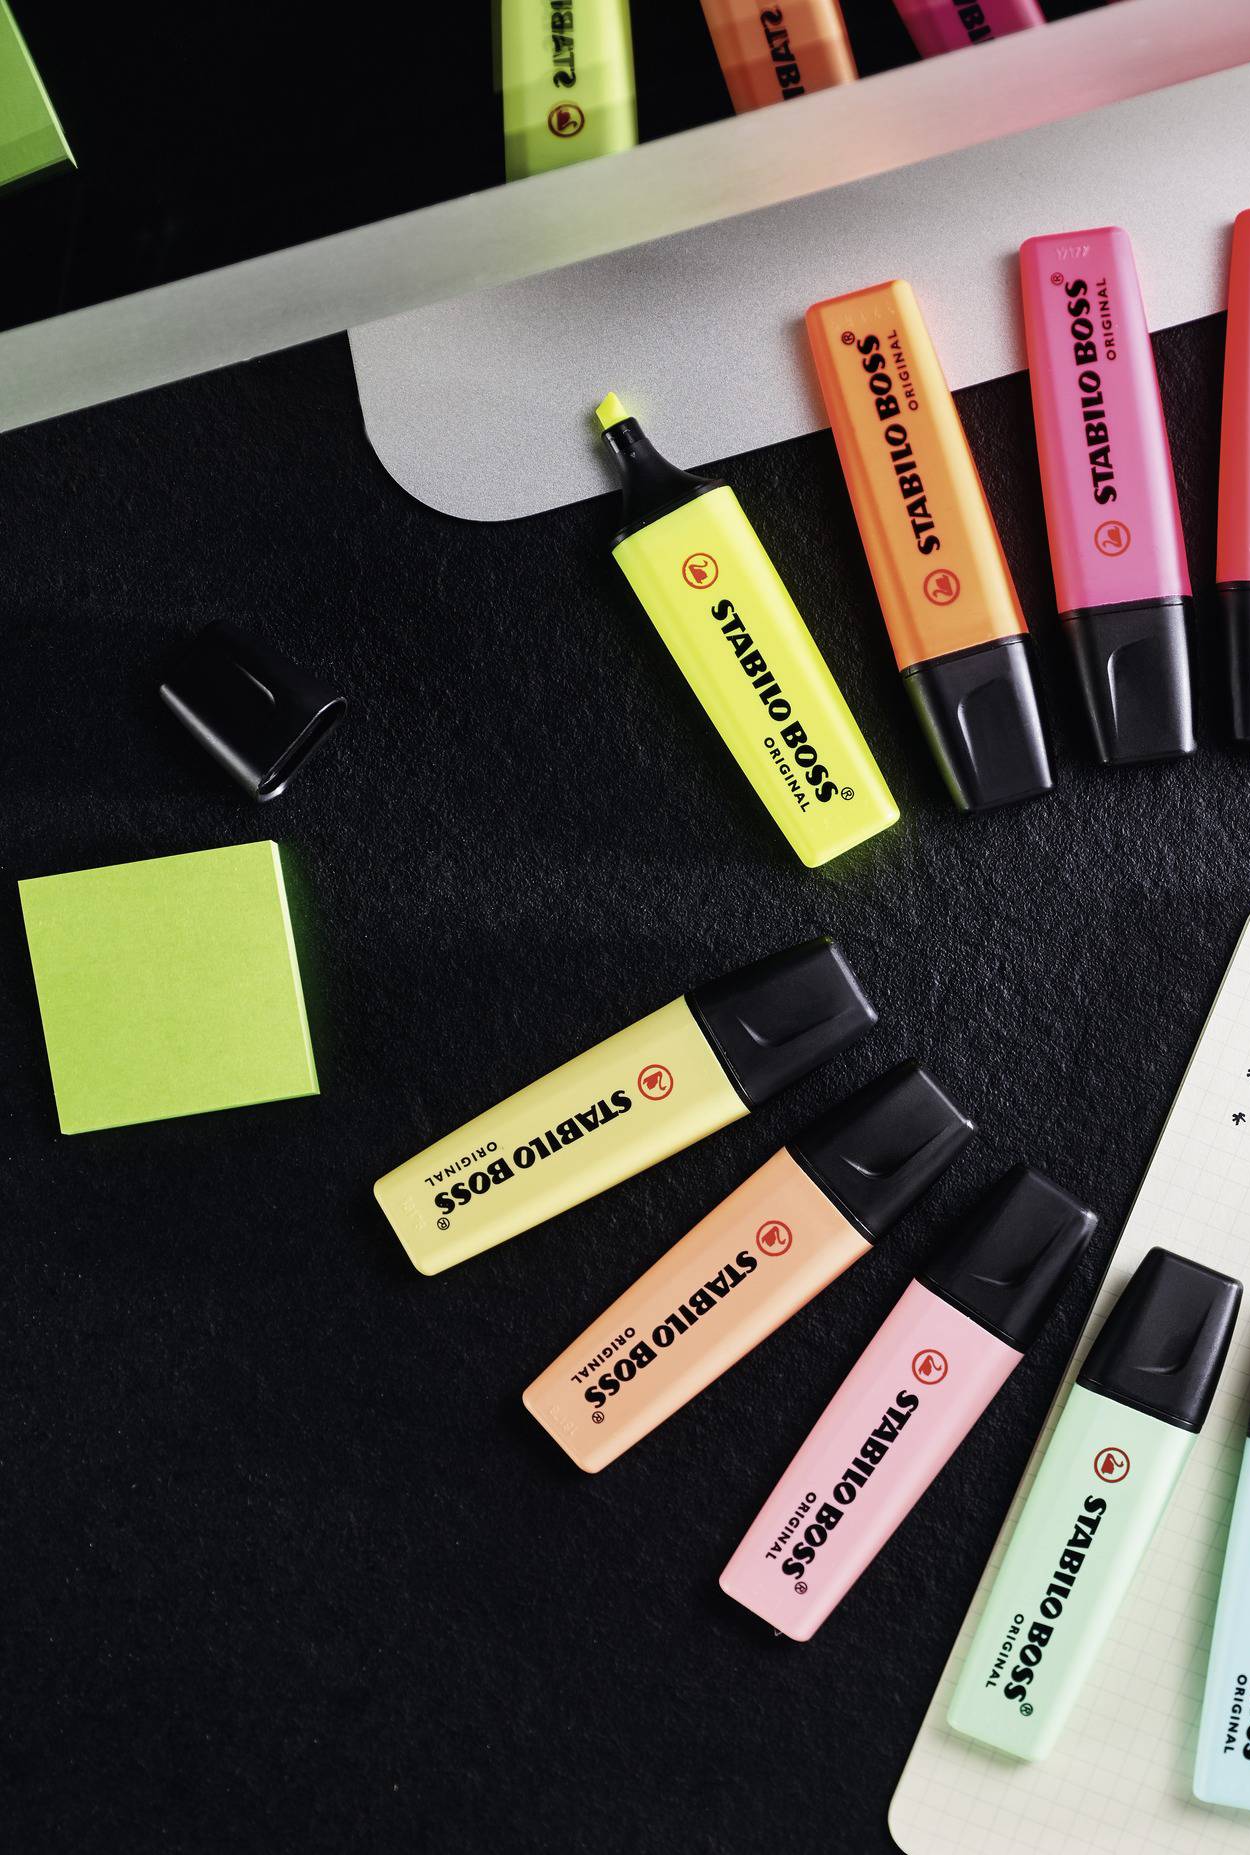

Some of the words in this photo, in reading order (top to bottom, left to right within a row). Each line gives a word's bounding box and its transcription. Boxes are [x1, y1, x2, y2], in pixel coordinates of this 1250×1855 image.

[1096, 277, 1117, 361] ORIGINAL
[888, 329, 920, 411] ORIGINAL
[1078, 370, 1117, 505] STABILO
[885, 424, 940, 555] STABILO
[711, 599, 791, 721] STABILO
[764, 737, 811, 813] ORIGINAL
[425, 1142, 498, 1187] ORIGINAL
[513, 1090, 632, 1169] STABILO
[652, 1251, 757, 1347] STABILO
[571, 1328, 636, 1384] ORIGINAL
[833, 1390, 919, 1505] STABILO
[765, 1492, 817, 1560] ORIGINAL
[1040, 1495, 1107, 1619] STABILO
[985, 1614, 1025, 1689] ORIGINAL
[1224, 1675, 1248, 1754] ORIGINAL
